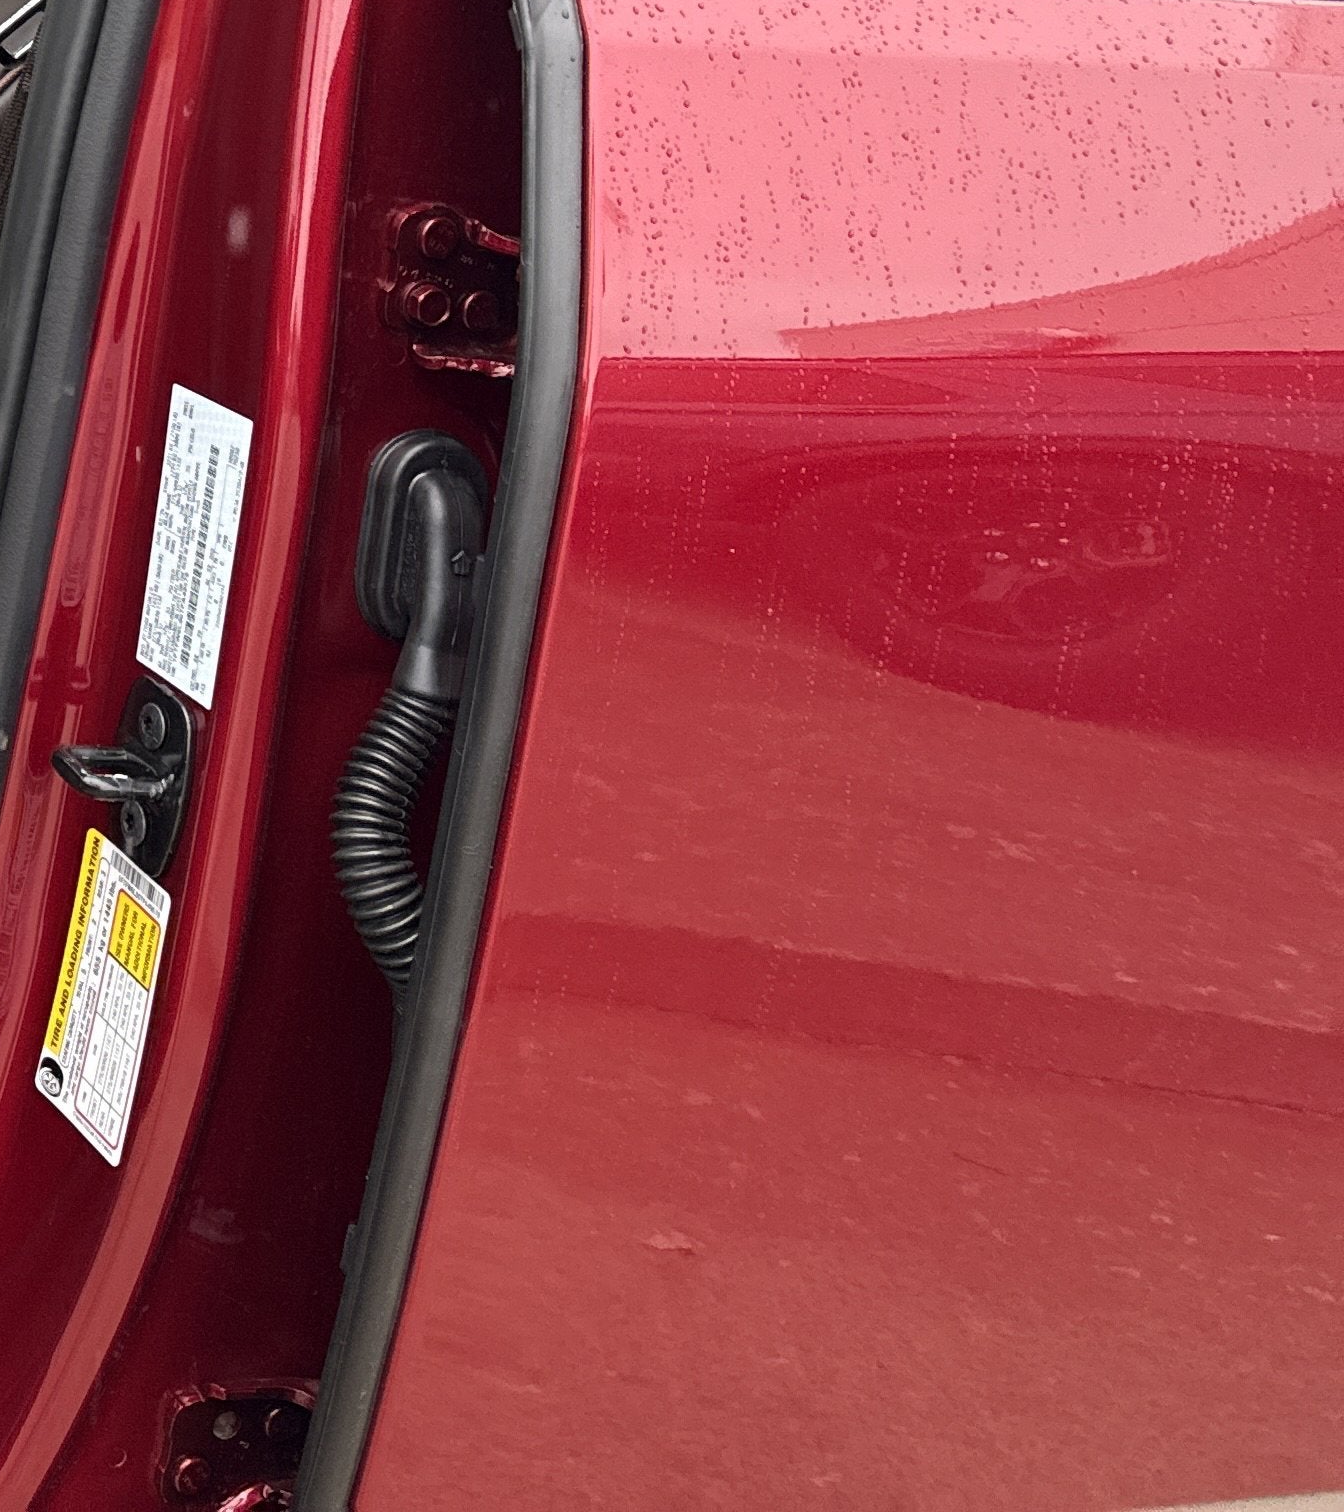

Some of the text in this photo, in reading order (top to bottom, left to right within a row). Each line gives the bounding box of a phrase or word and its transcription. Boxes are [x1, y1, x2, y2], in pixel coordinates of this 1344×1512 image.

[50, 834, 100, 1050] TIRE AND LOADING INFORMATION
[101, 925, 107, 938] or
[114, 940, 122, 958] SEE
[123, 909, 138, 967] MANUAL FOR
[132, 920, 146, 973] ADDITIONAL
[140, 922, 156, 984] INFORMATION
